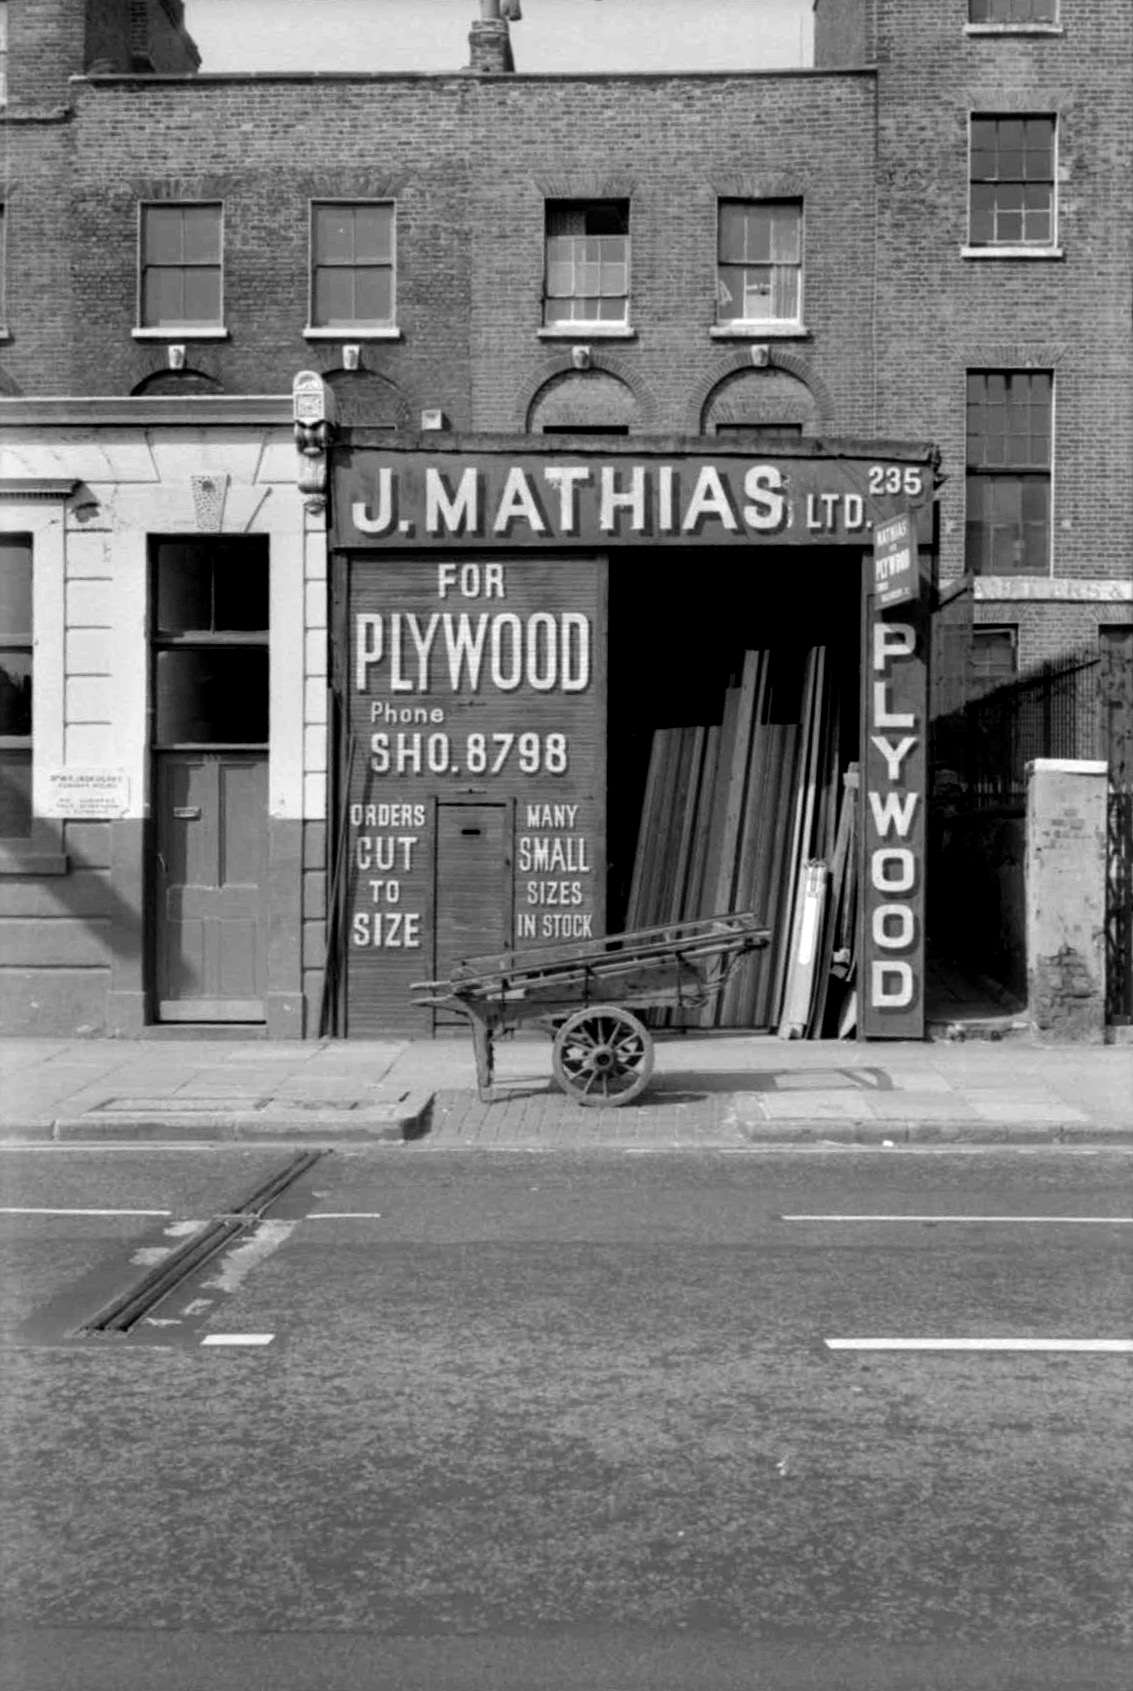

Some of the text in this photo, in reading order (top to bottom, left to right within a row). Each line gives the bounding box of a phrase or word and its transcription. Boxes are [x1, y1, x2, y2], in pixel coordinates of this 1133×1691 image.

[868, 466, 922, 495] 235
[806, 493, 872, 529] LTD.
[437, 563, 505, 598] FOR
[355, 612, 590, 692] PLYWOOD
[370, 701, 445, 724] Phone
[350, 804, 426, 826] ORDERS
[527, 804, 579, 828] MANY
[868, 622, 918, 1007] PLYWOOD
[357, 836, 418, 870] CUT
[519, 837, 591, 872] SMALL
[369, 880, 401, 903] TO
[527, 881, 583, 906] SIZES
[353, 912, 421, 948] SIZE
[517, 914, 593, 938] IN STOCK
